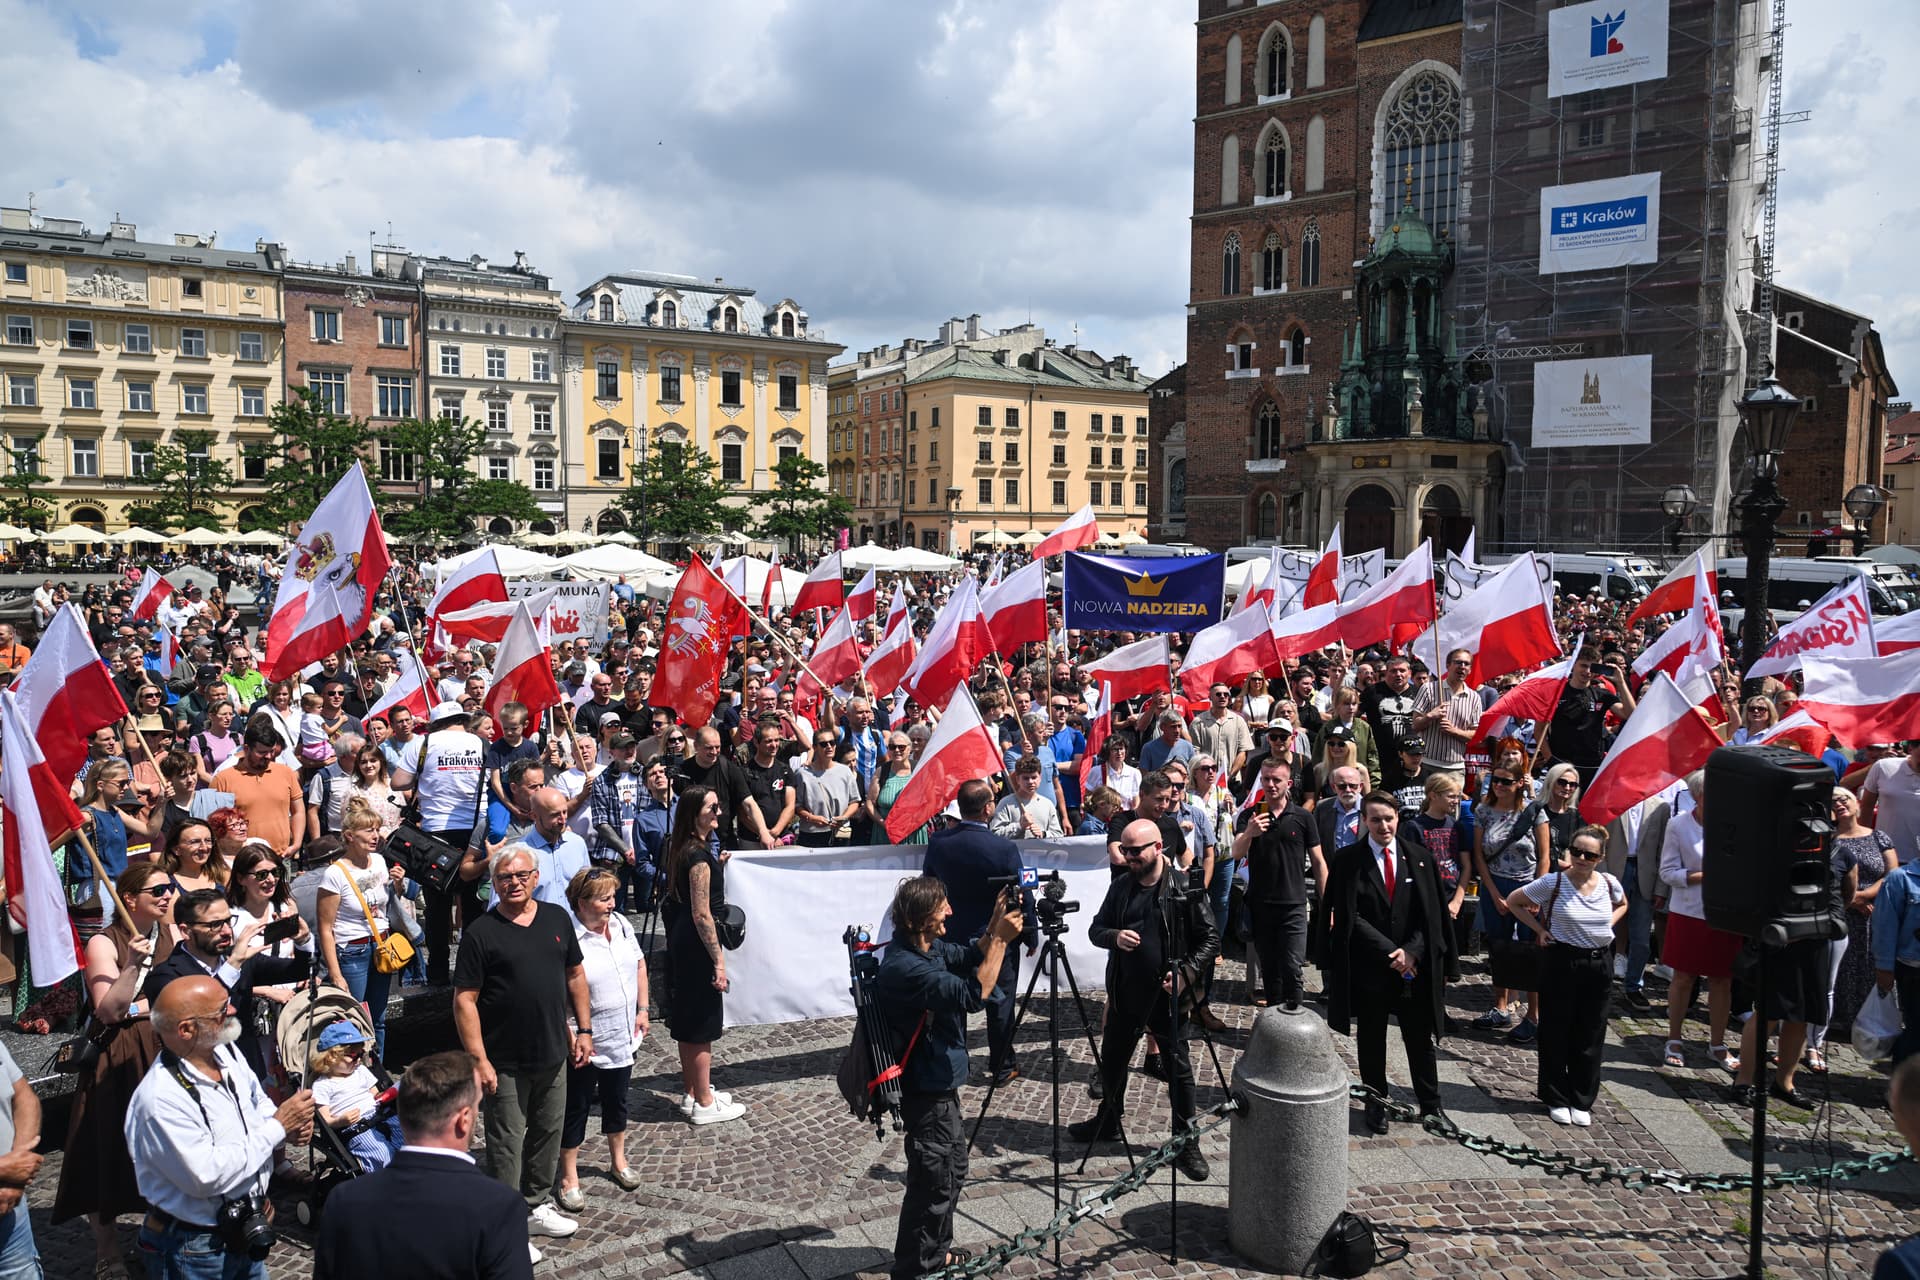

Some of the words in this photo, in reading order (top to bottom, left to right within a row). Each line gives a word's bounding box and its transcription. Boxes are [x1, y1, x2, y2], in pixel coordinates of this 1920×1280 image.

[1583, 206, 1636, 224] Kraków
[1281, 550, 1375, 574] CHMY
[539, 586, 600, 598] KMUNĄ
[1073, 600, 1124, 614] NOWA
[1127, 602, 1208, 616] NADZIEJA
